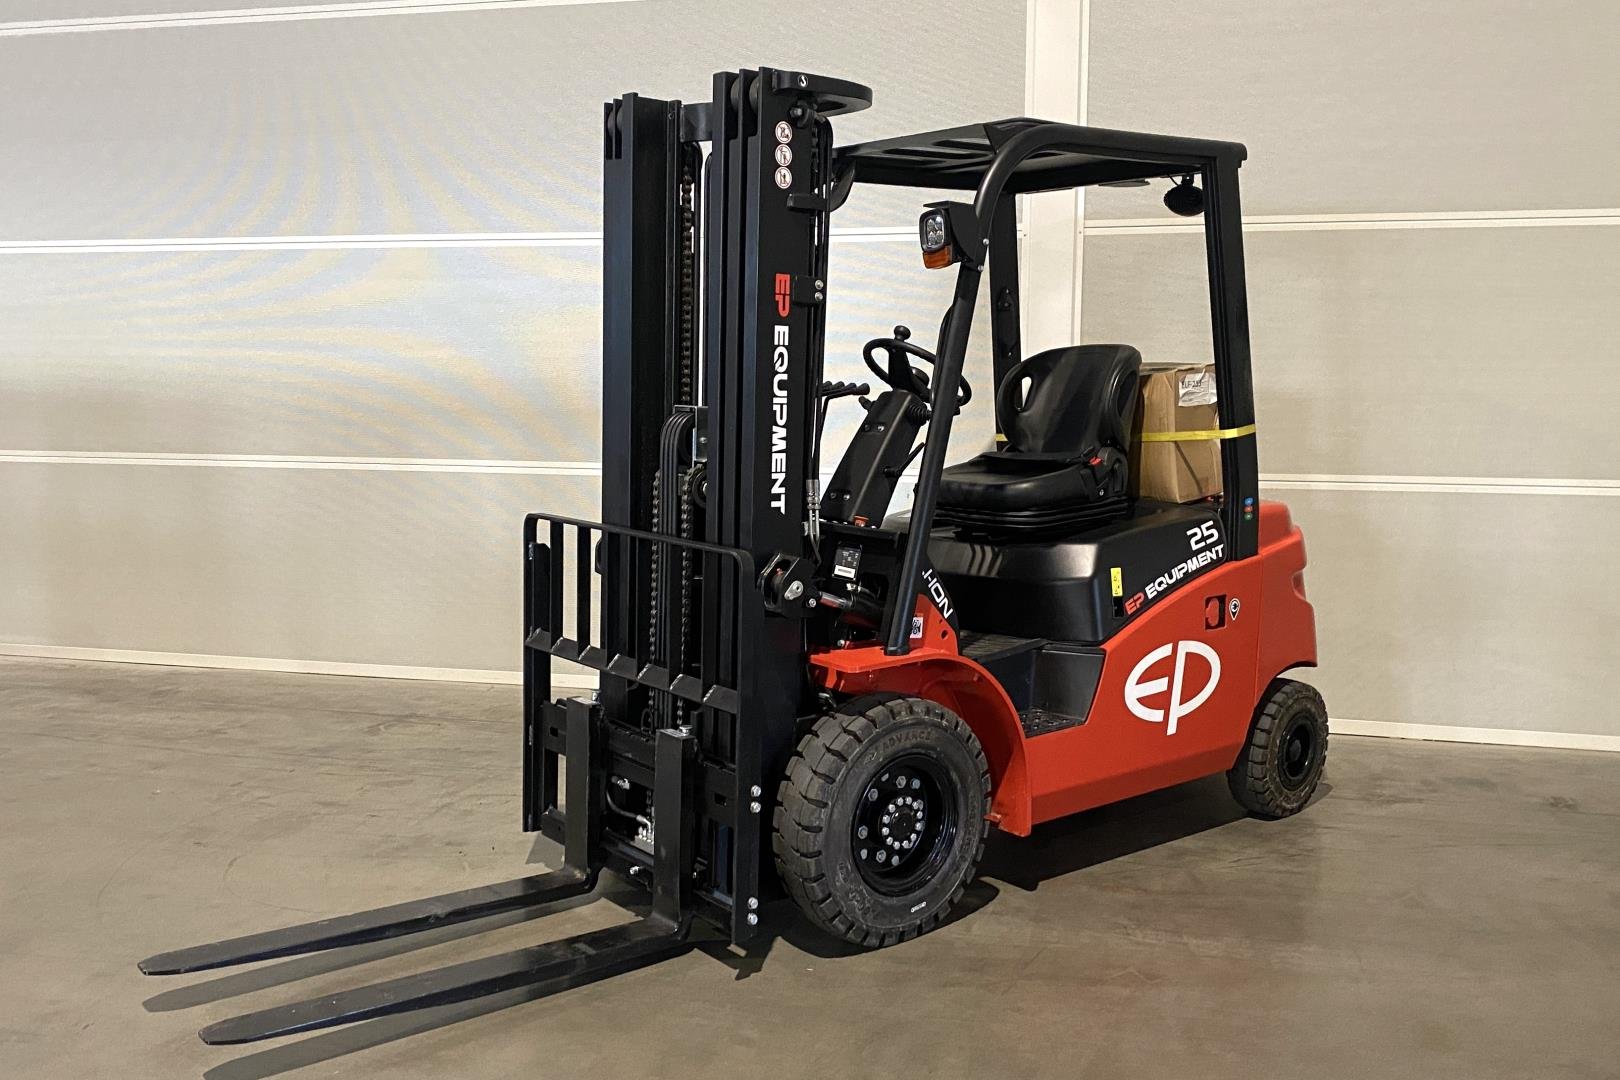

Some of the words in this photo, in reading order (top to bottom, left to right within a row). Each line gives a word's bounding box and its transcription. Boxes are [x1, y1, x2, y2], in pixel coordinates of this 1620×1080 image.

[775, 273, 791, 318] EP
[770, 324, 790, 515] EQUIPMENT
[1186, 520, 1220, 551] 25
[1124, 592, 1145, 615] EP
[1144, 544, 1225, 600] EQUIPMENT
[1124, 640, 1221, 736] EP
